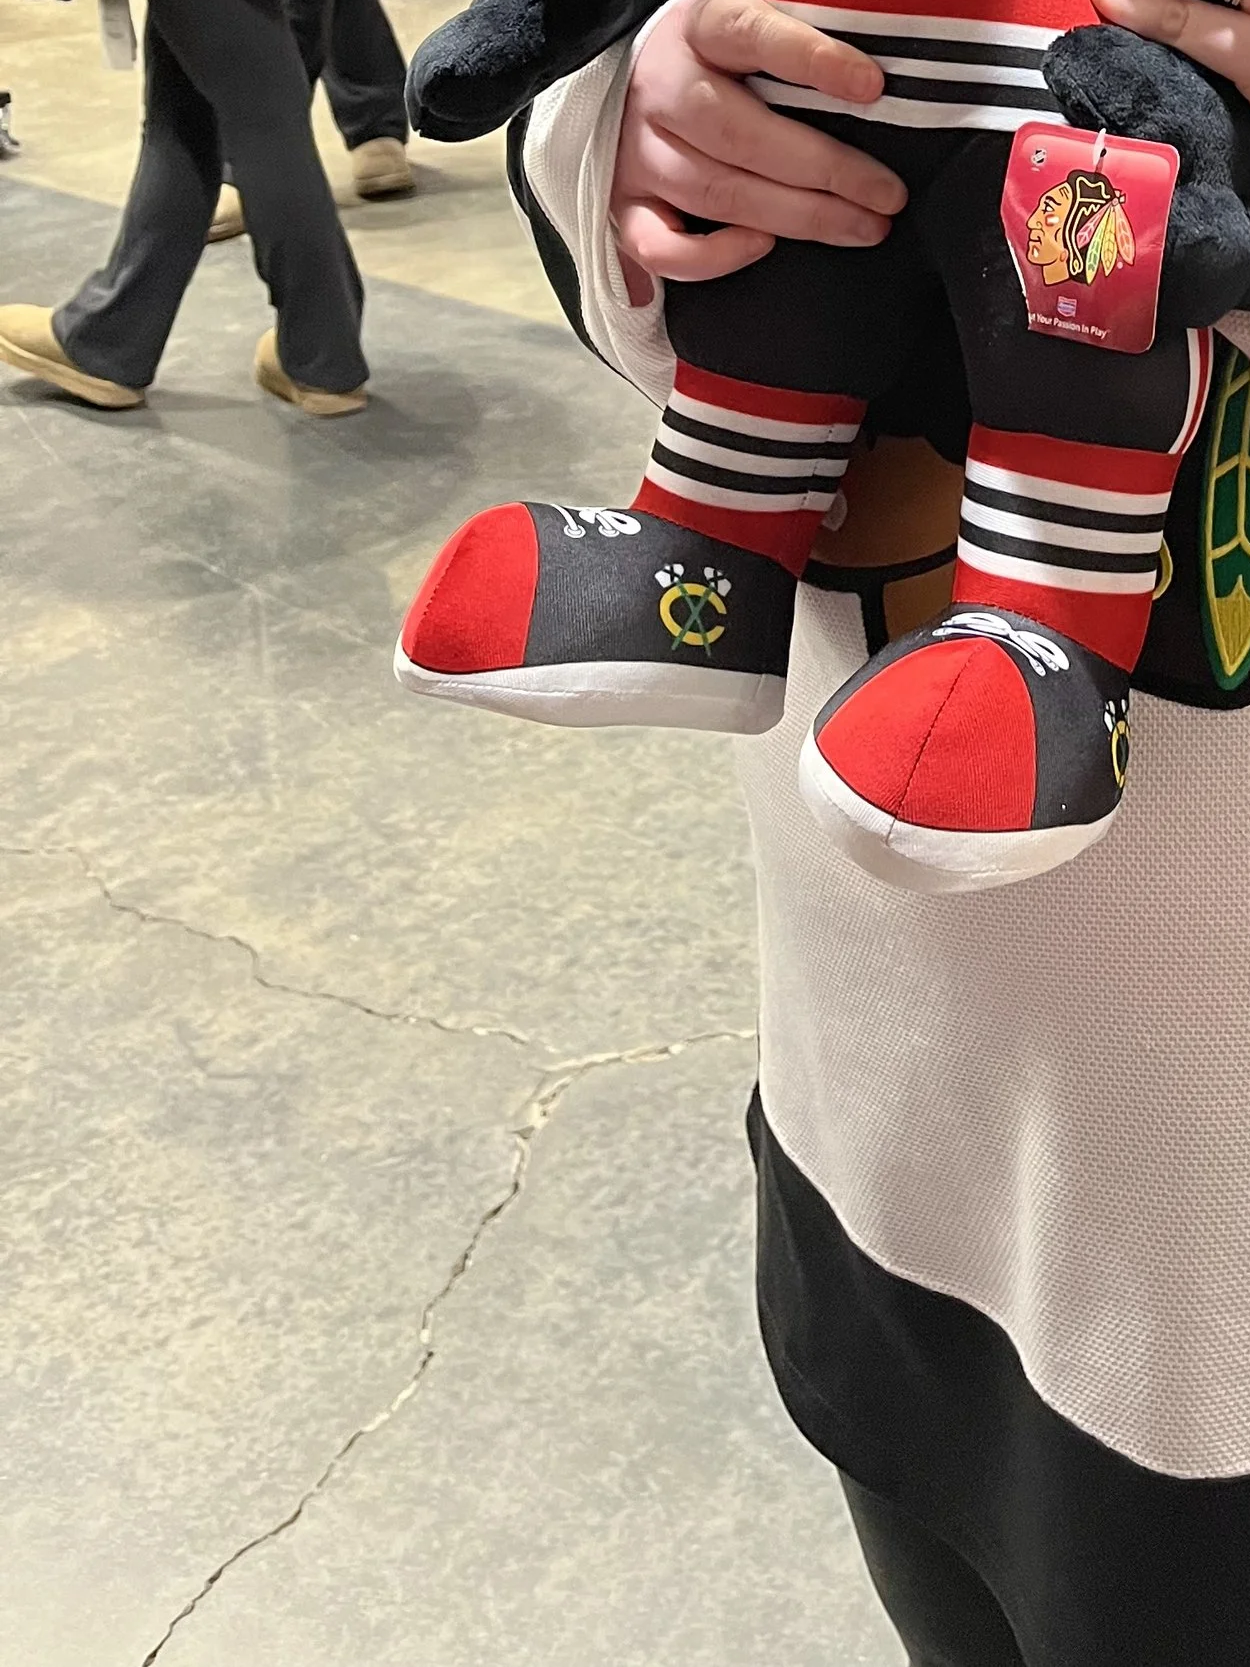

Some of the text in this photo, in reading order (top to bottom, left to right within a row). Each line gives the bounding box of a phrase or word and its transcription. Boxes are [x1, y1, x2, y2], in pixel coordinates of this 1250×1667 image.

[1036, 313, 1053, 325] Your
[1053, 317, 1081, 332] Passion
[1090, 326, 1108, 340] Play
